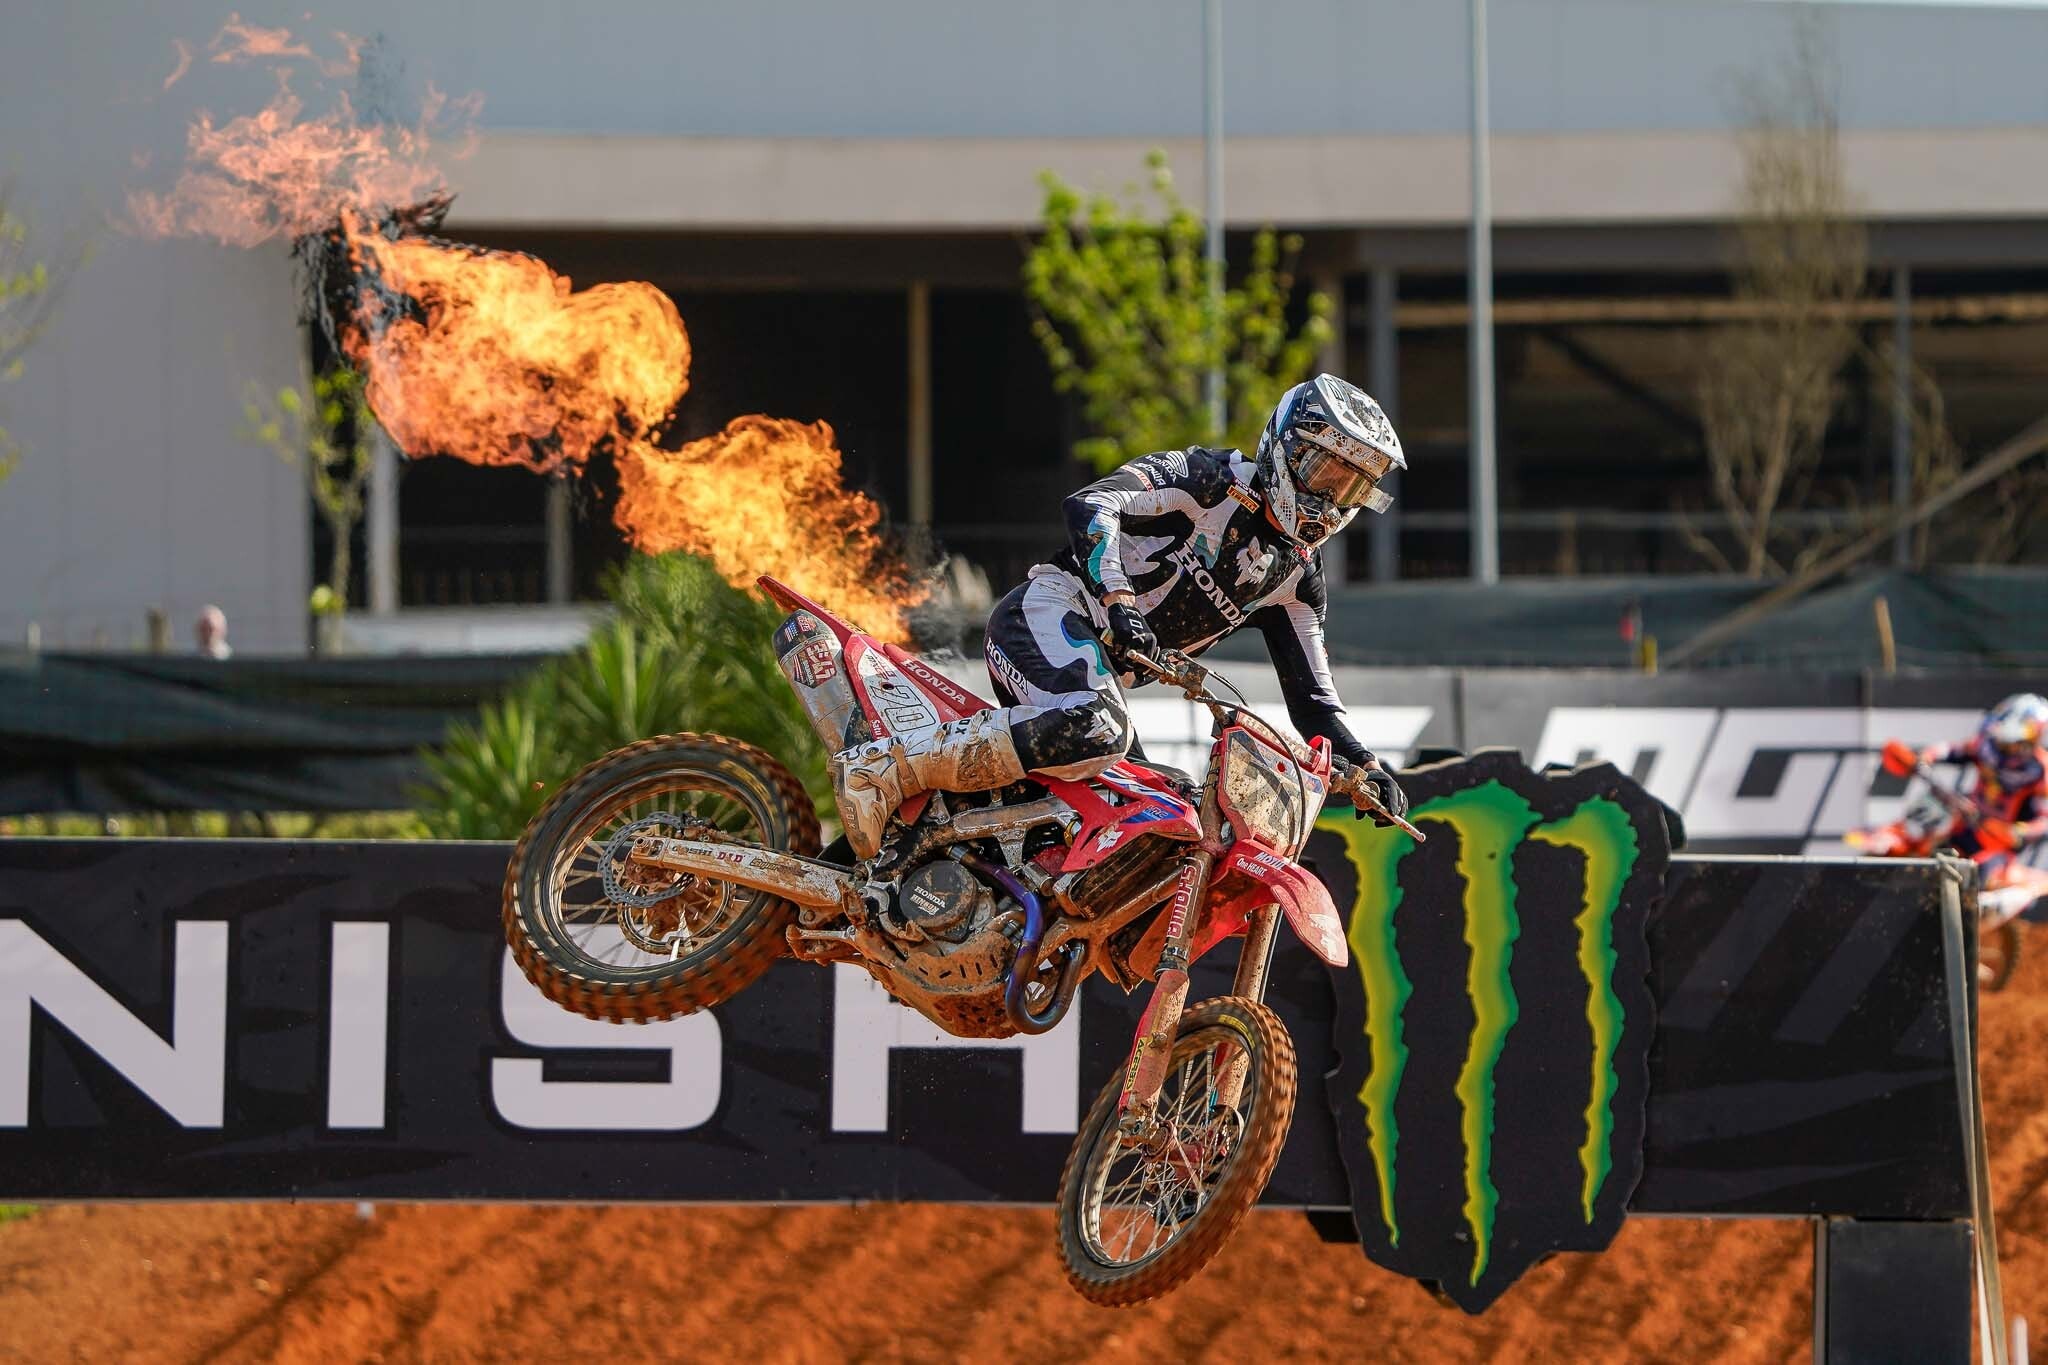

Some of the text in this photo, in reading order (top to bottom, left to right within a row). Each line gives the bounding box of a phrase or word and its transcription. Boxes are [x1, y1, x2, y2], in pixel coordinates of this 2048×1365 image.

[1145, 455, 1178, 483] HONDA
[1174, 541, 1245, 629] HONDA
[1126, 608, 1146, 644] FOX
[901, 658, 967, 705] HONDA
[986, 637, 1029, 696] HONDA
[870, 684, 937, 732] 70
[955, 718, 971, 735] OX
[845, 806, 856, 830] FOX
[1236, 858, 1249, 869] One
[1254, 851, 1286, 870] MOTUL
[914, 885, 946, 908] HONDA
[1169, 864, 1197, 938] SHOWA
